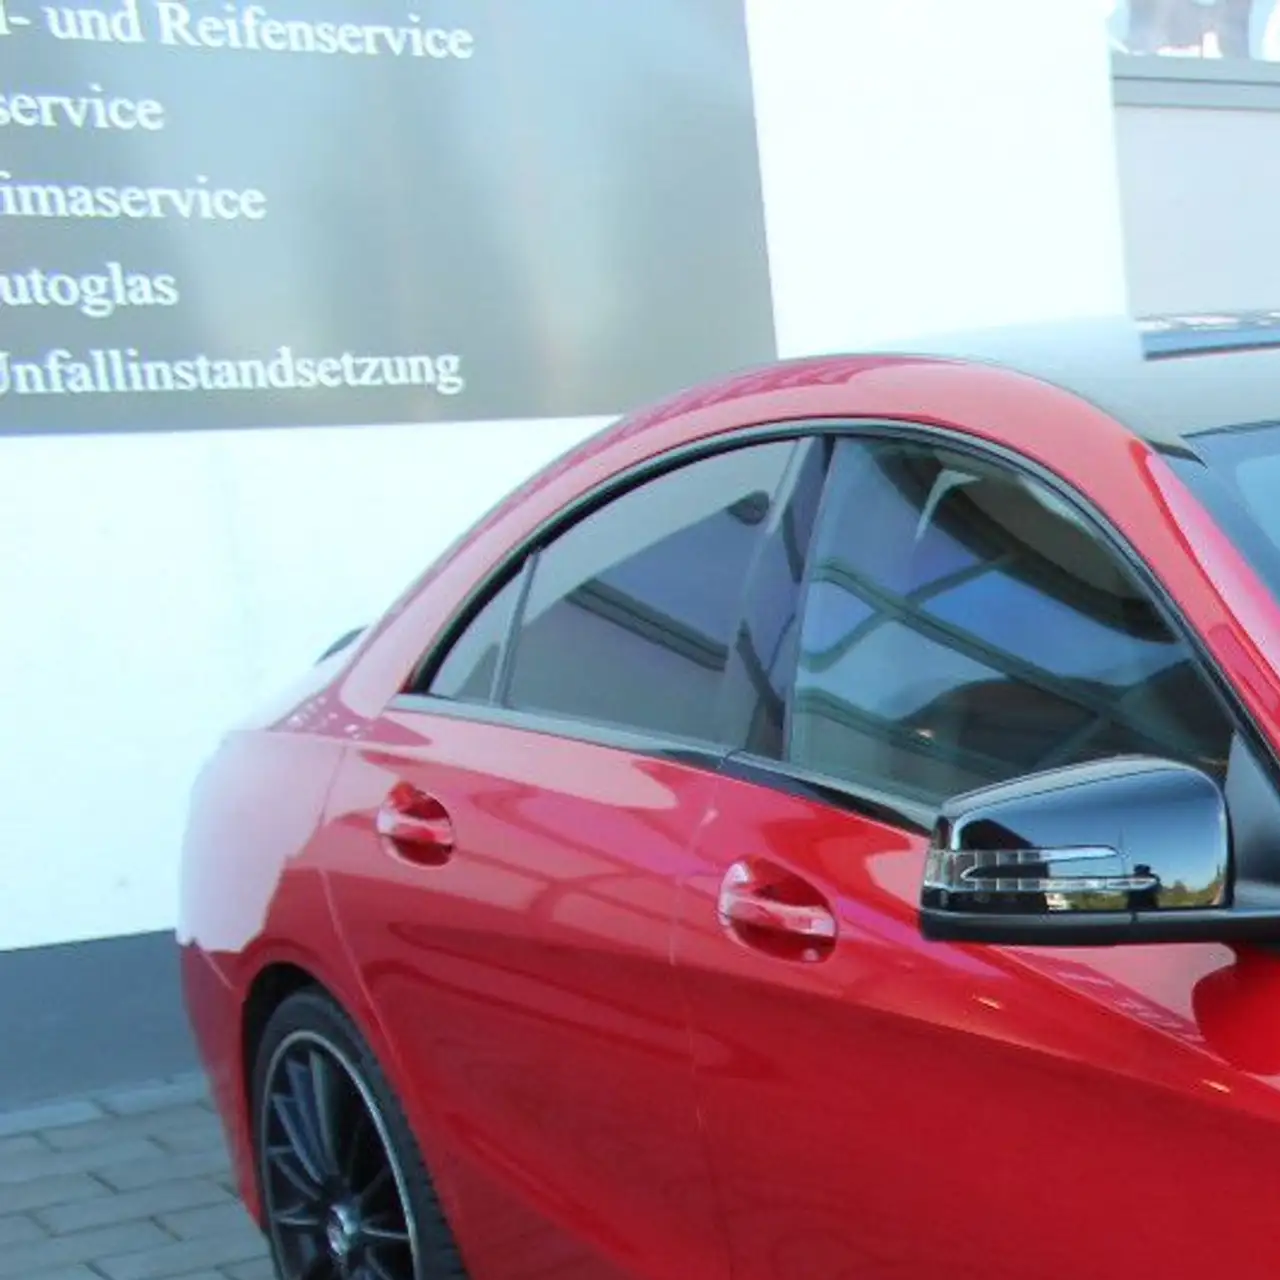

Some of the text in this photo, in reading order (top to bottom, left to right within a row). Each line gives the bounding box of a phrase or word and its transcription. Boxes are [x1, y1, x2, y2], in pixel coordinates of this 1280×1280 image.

[41, 0, 146, 42] und
[157, 1, 474, 59] Reifenservice
[0, 261, 179, 318] utoglas
